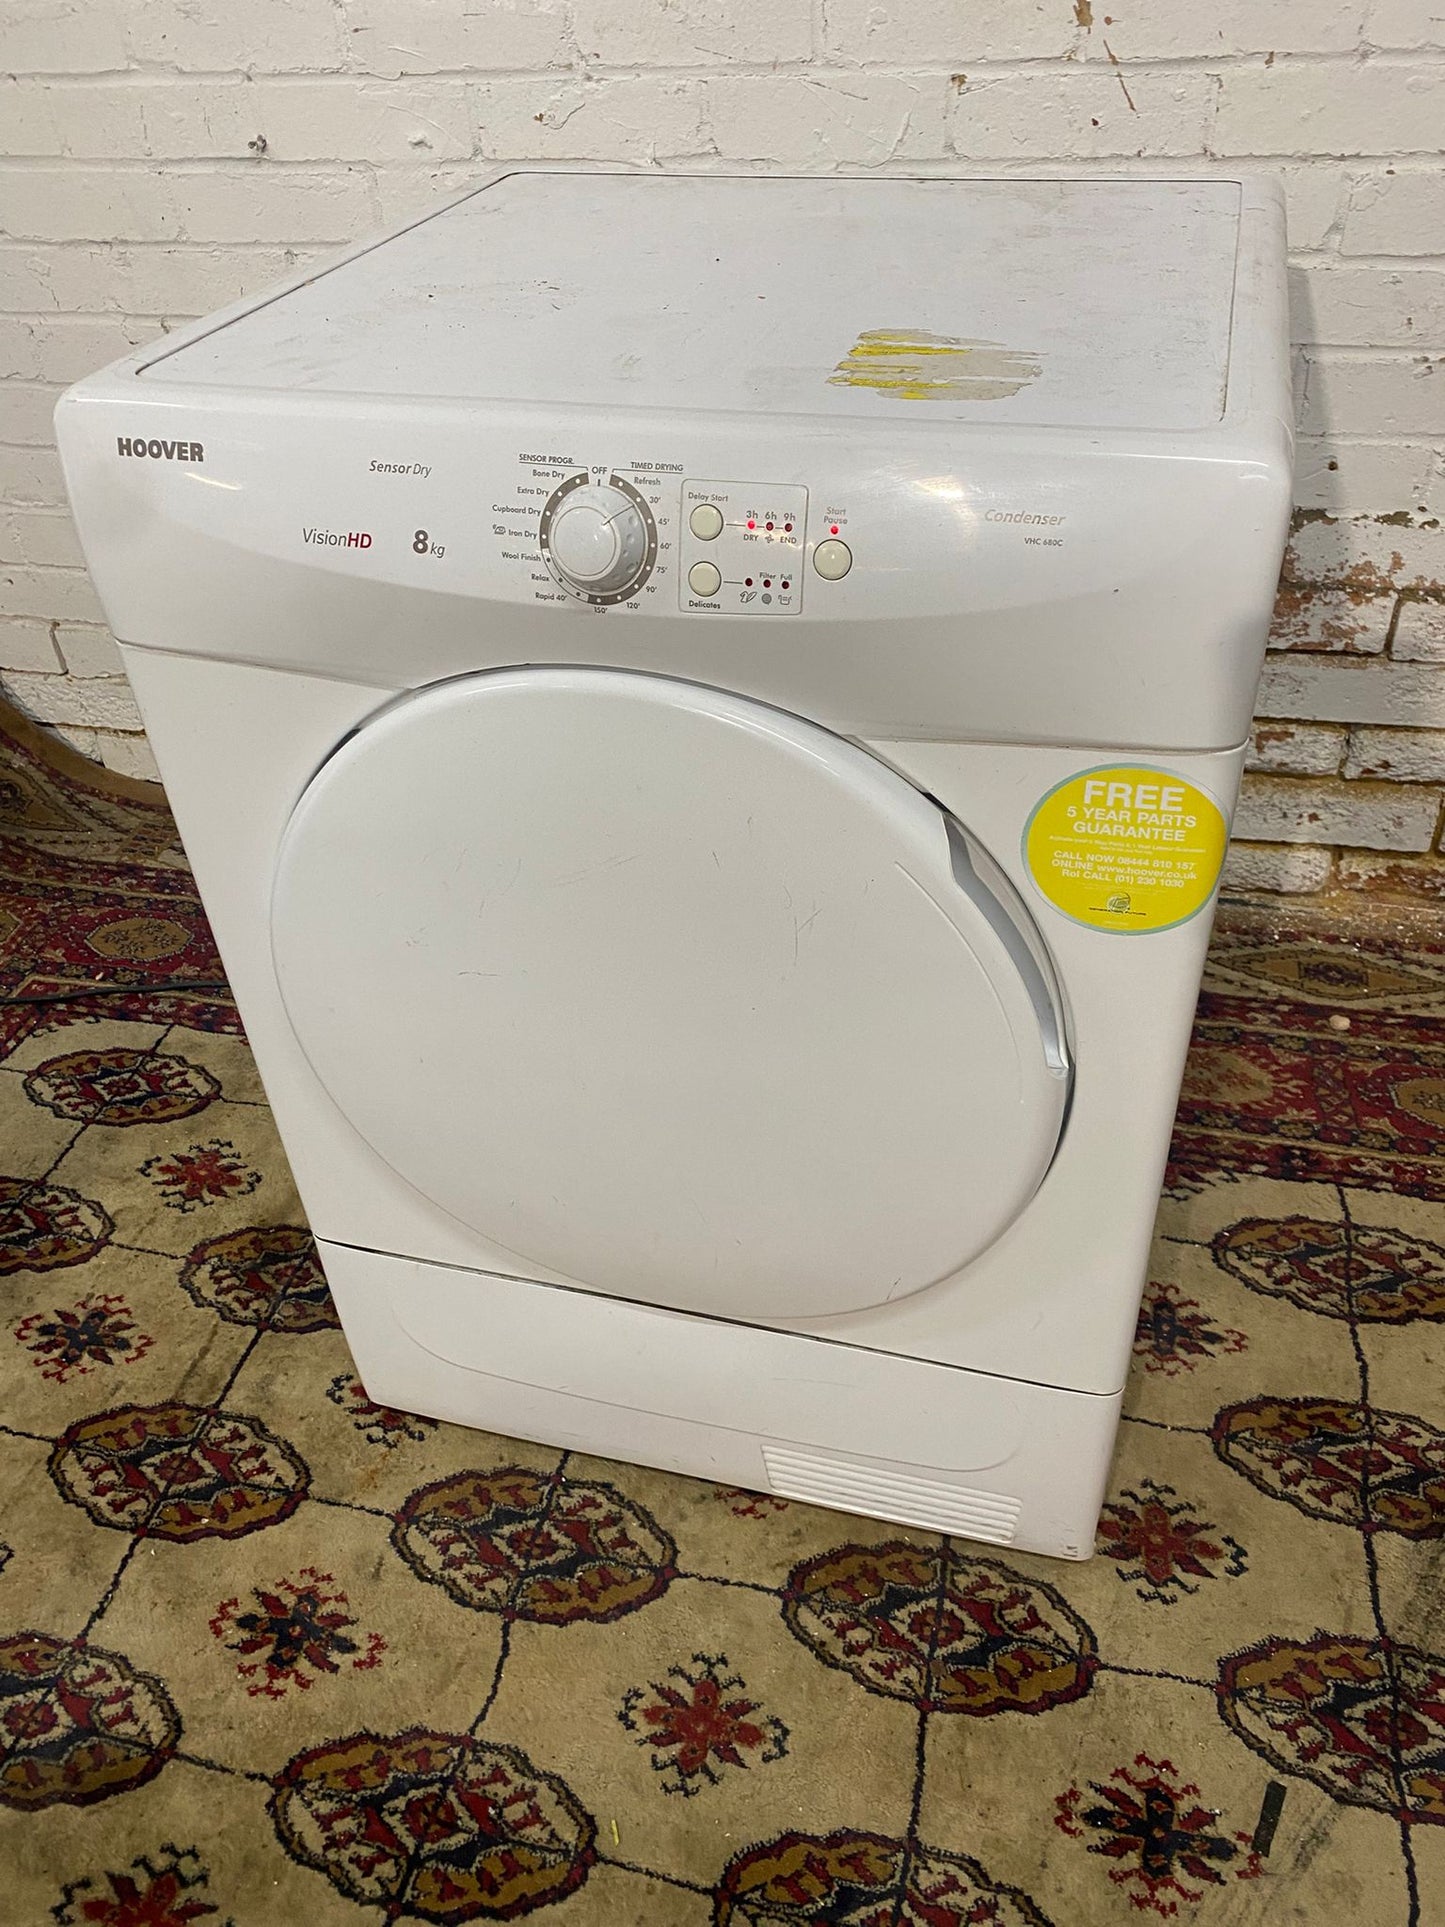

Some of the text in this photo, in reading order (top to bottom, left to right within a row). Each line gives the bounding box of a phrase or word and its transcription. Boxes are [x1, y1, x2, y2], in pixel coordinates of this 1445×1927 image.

[117, 437, 205, 462] HOOVER
[519, 454, 547, 463] SENSOR
[591, 466, 608, 475] OFF
[630, 462, 684, 472] TIMED DRYING
[532, 469, 566, 480] Bone Dry
[634, 477, 661, 486] Refresh
[517, 487, 550, 497] Extra Dry
[688, 492, 729, 502] Delay Start
[492, 505, 541, 516] Cupboard Dry
[746, 510, 796, 521] 3h 6h 9h
[826, 507, 847, 515] Start
[824, 516, 848, 525] Pause
[985, 509, 1066, 526] Condenser
[302, 528, 373, 550] VisionHD
[508, 529, 537, 540] Iron Dry
[780, 536, 797, 544] END
[1024, 537, 1041, 545] VHC
[502, 551, 541, 562] Wool Finish
[531, 573, 550, 582] Relax
[759, 572, 776, 580] Filter
[535, 592, 555, 602] Rapid
[689, 600, 721, 610] Delicates
[1083, 780, 1185, 812] FREE
[1067, 806, 1197, 828] 5 YEAR PARTS
[1073, 821, 1186, 842] GUARANTEE
[1053, 850, 1083, 861] CALL
[1086, 854, 1115, 864] NOW
[1051, 859, 1198, 880] ONLINE www.hoover.co.uk
[1084, 871, 1111, 881] CALL
[1114, 874, 1134, 885] (01)
